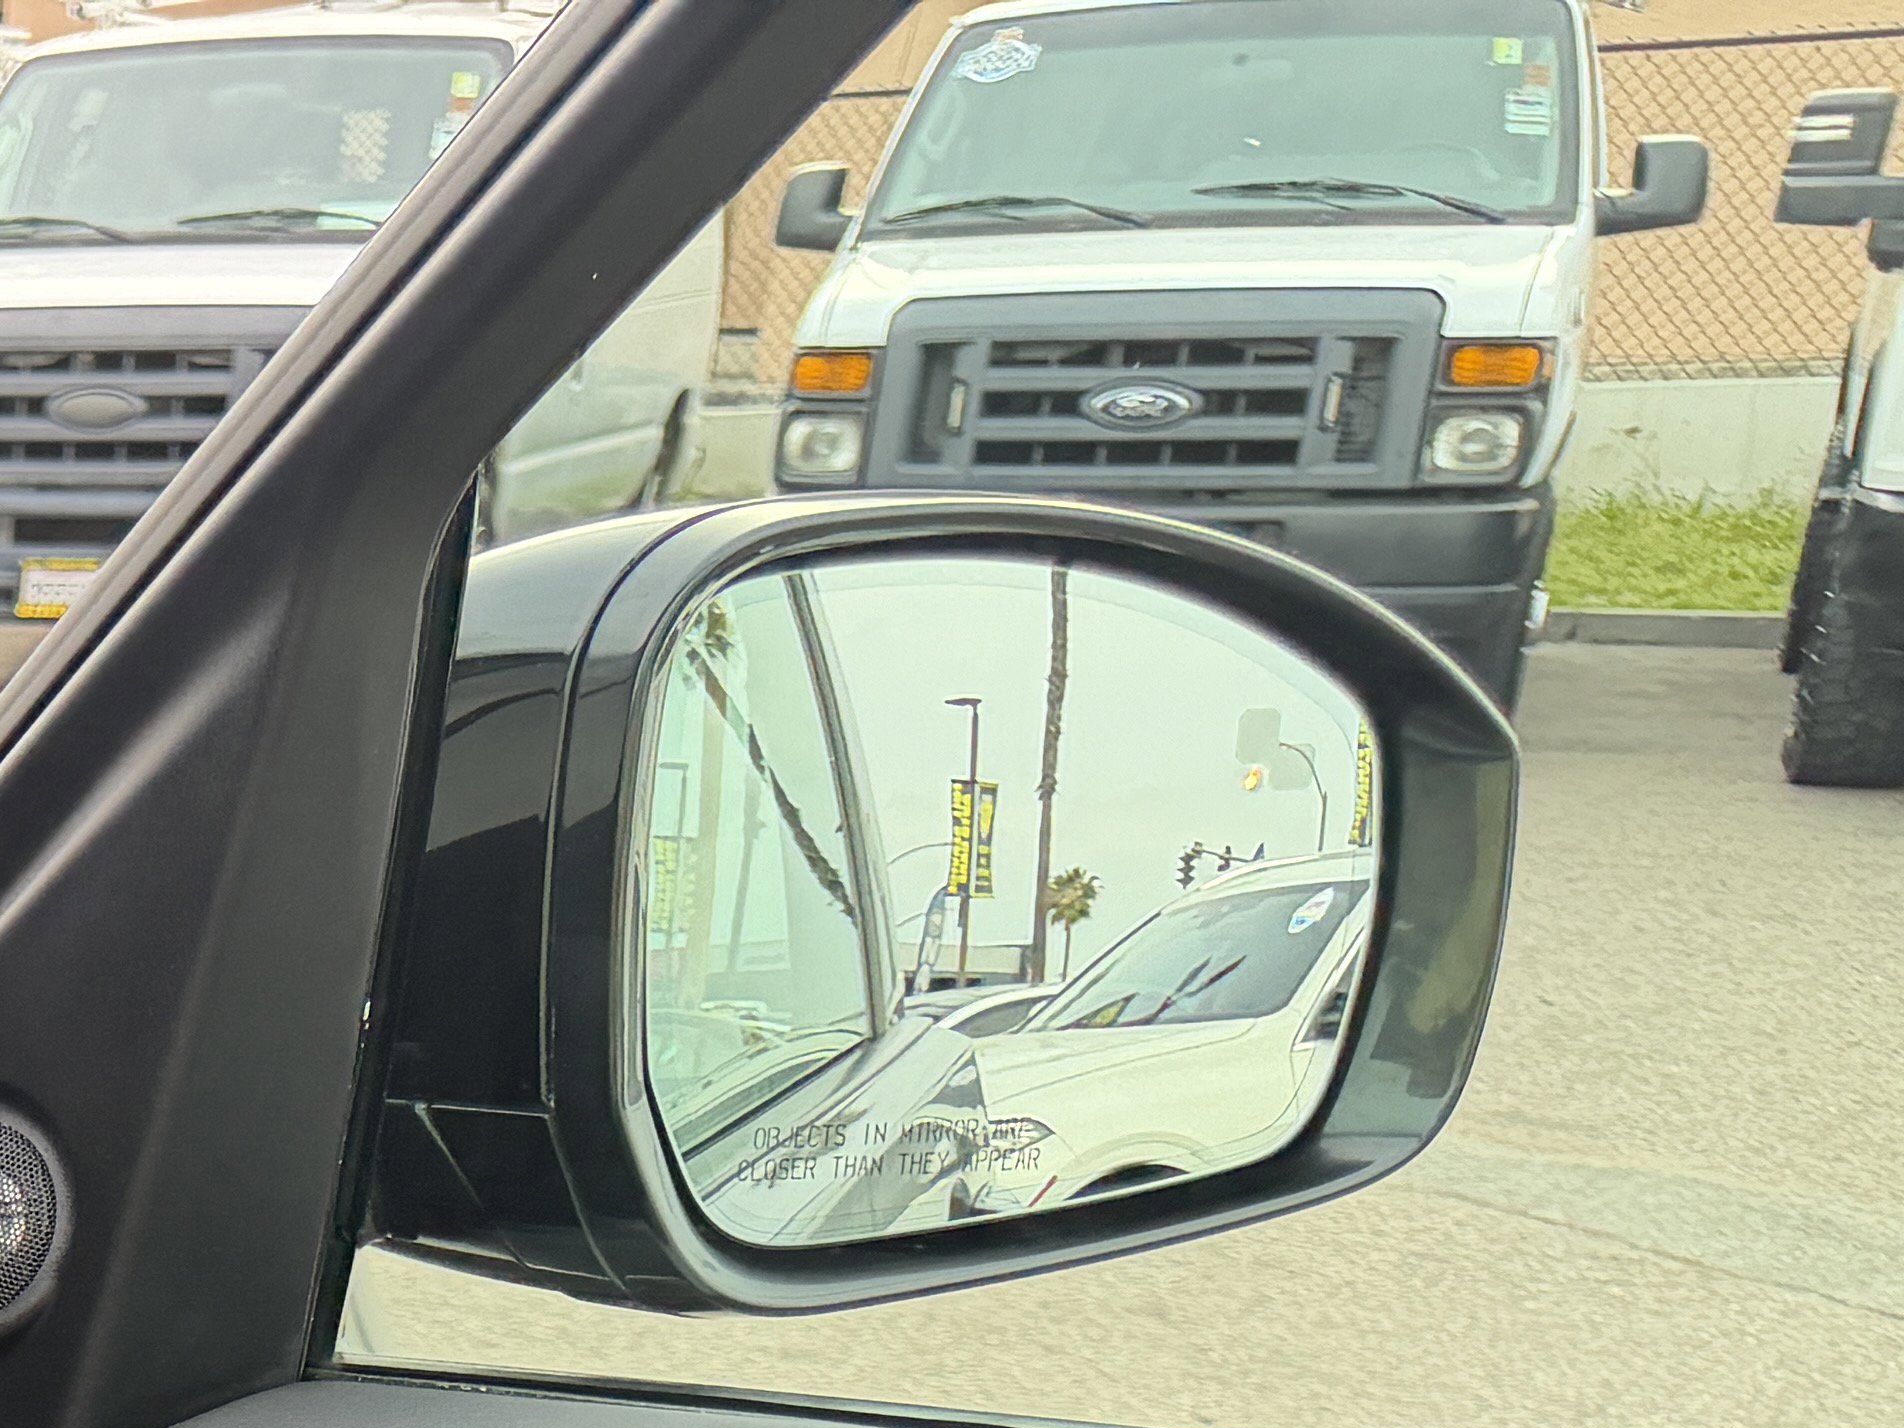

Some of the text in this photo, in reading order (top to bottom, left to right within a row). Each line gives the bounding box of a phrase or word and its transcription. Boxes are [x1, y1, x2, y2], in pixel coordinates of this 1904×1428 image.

[753, 1124, 847, 1150] OBJECTS
[864, 1122, 887, 1146] IN
[901, 1119, 978, 1144] MIRROR
[738, 1148, 1041, 1183] CLOSER THAN THEY APPEAR
